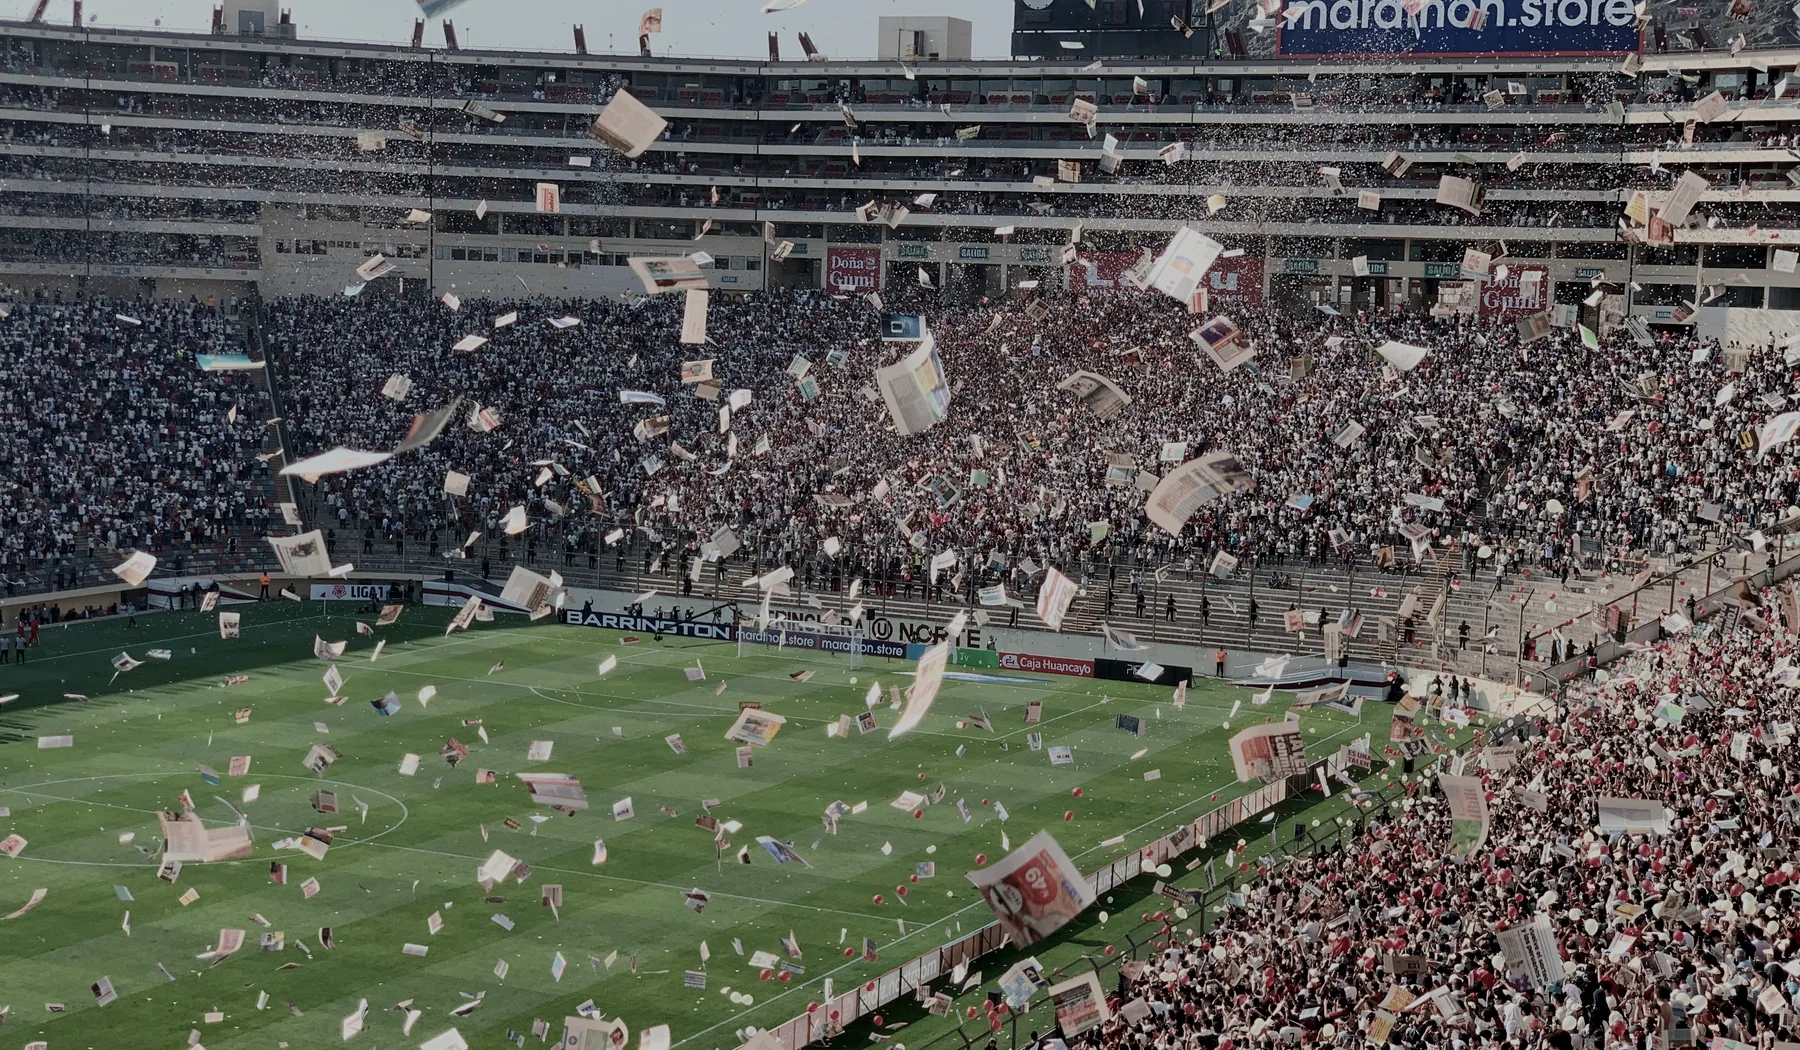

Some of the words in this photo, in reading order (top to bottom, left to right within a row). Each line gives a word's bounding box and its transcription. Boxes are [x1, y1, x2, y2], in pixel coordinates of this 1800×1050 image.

[961, 248, 987, 258] SALIDA
[831, 254, 864, 270] Doña
[1427, 265, 1458, 276] SALIDA
[829, 270, 875, 289] Gumi
[566, 610, 731, 640] BARRINGTON
[1020, 657, 1041, 670] Caja
[1043, 660, 1091, 676] Huancayo
[1347, 749, 1358, 758] ES
